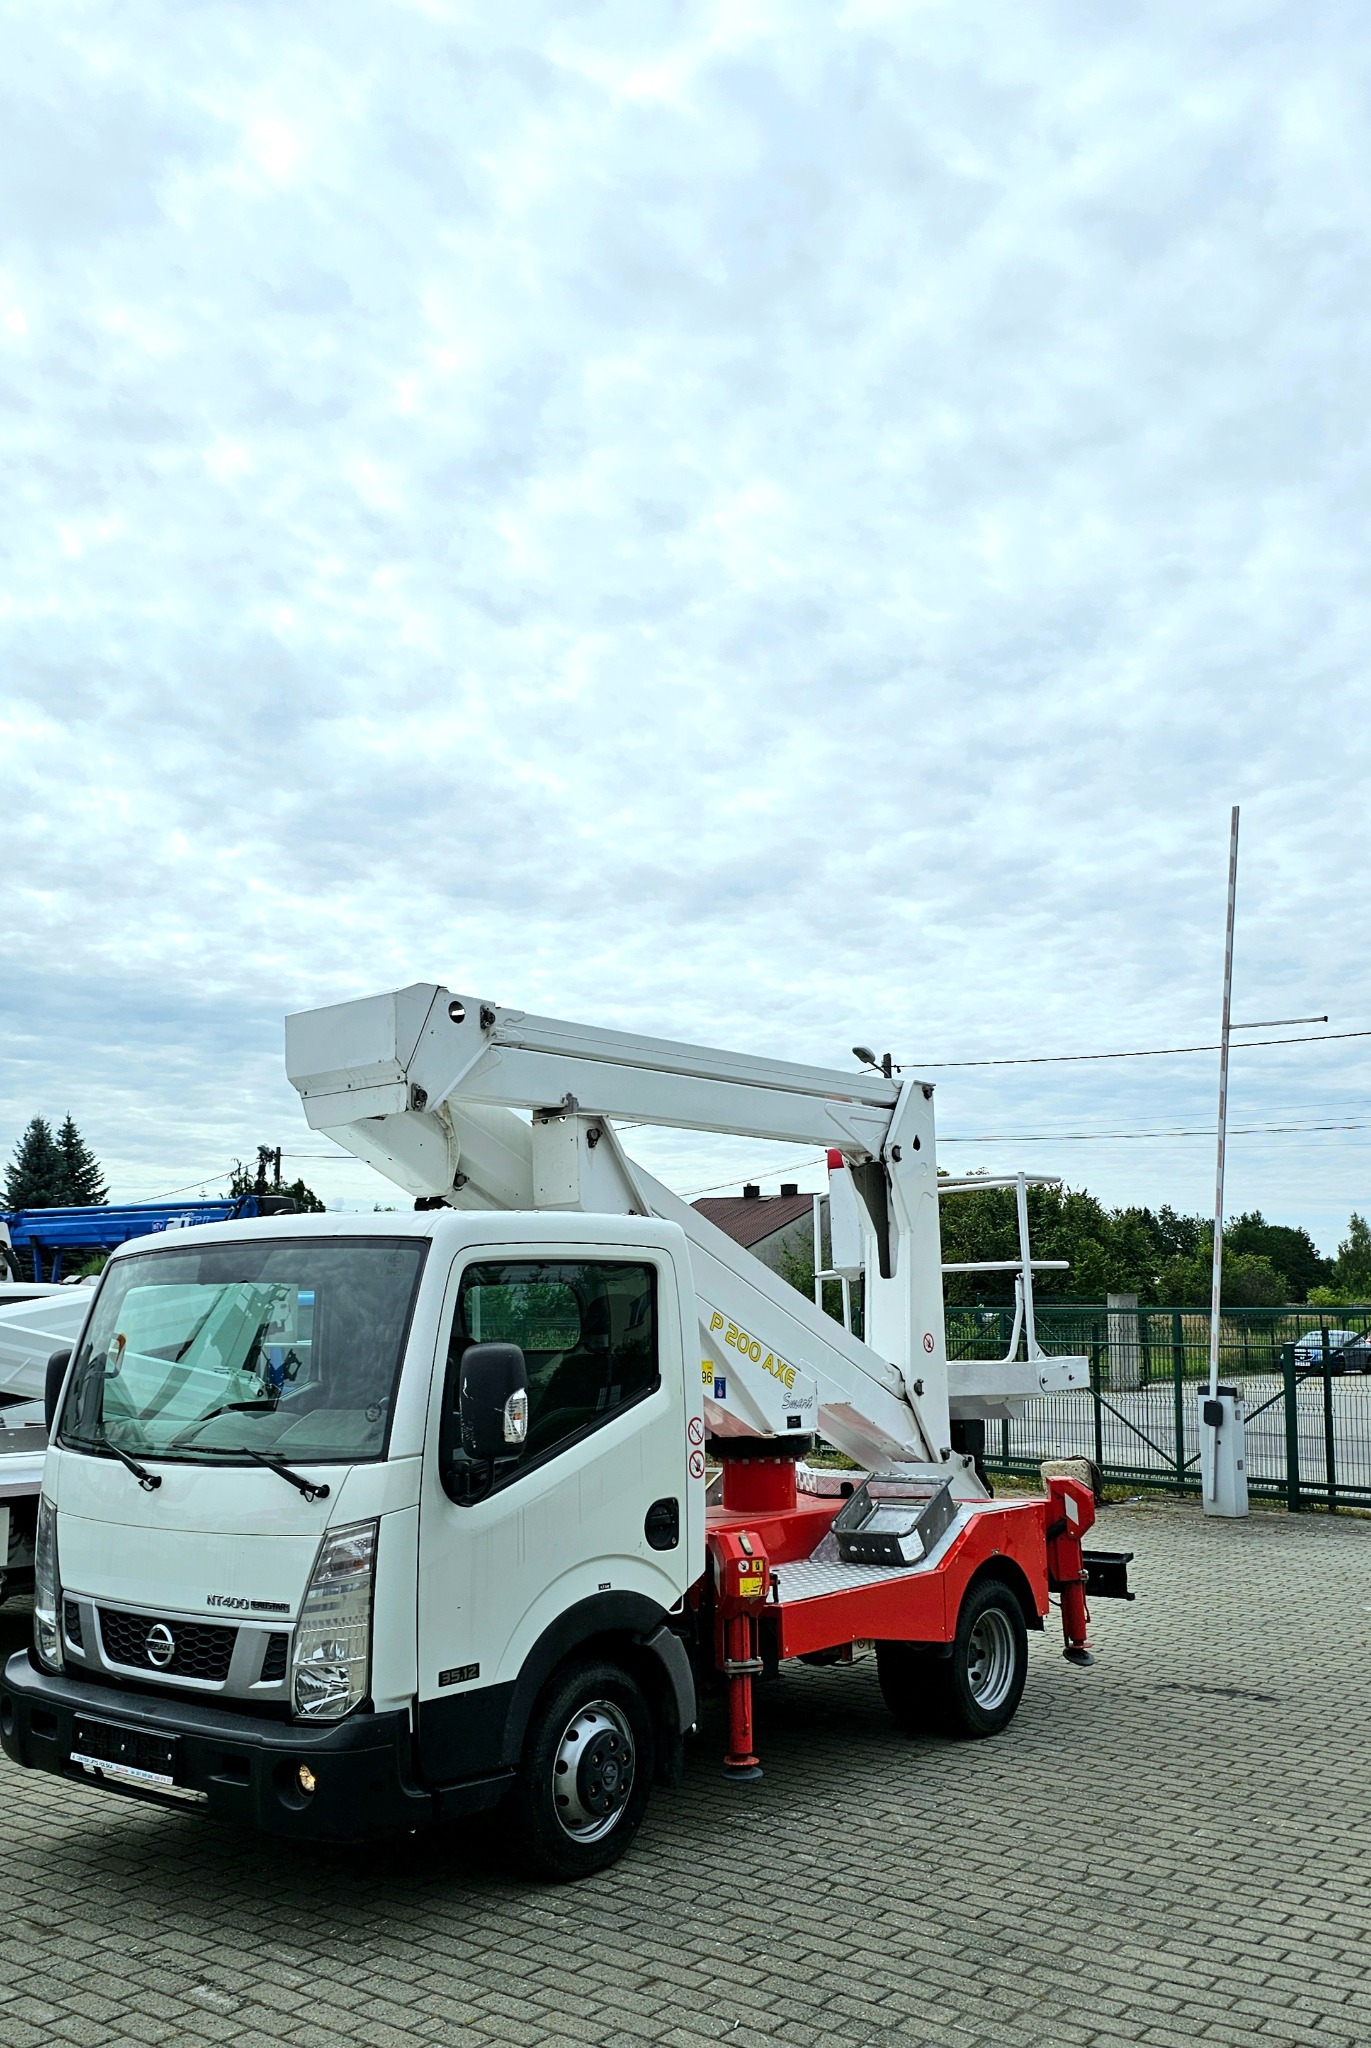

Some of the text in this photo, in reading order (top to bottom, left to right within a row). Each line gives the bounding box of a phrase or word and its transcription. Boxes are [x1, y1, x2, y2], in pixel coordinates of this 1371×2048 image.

[710, 1312, 796, 1389] P 200 AXE
[702, 1371, 713, 1383] 96
[782, 1392, 813, 1409] Smart
[206, 1594, 249, 1610] NT400
[441, 1666, 478, 1685] 35.12
